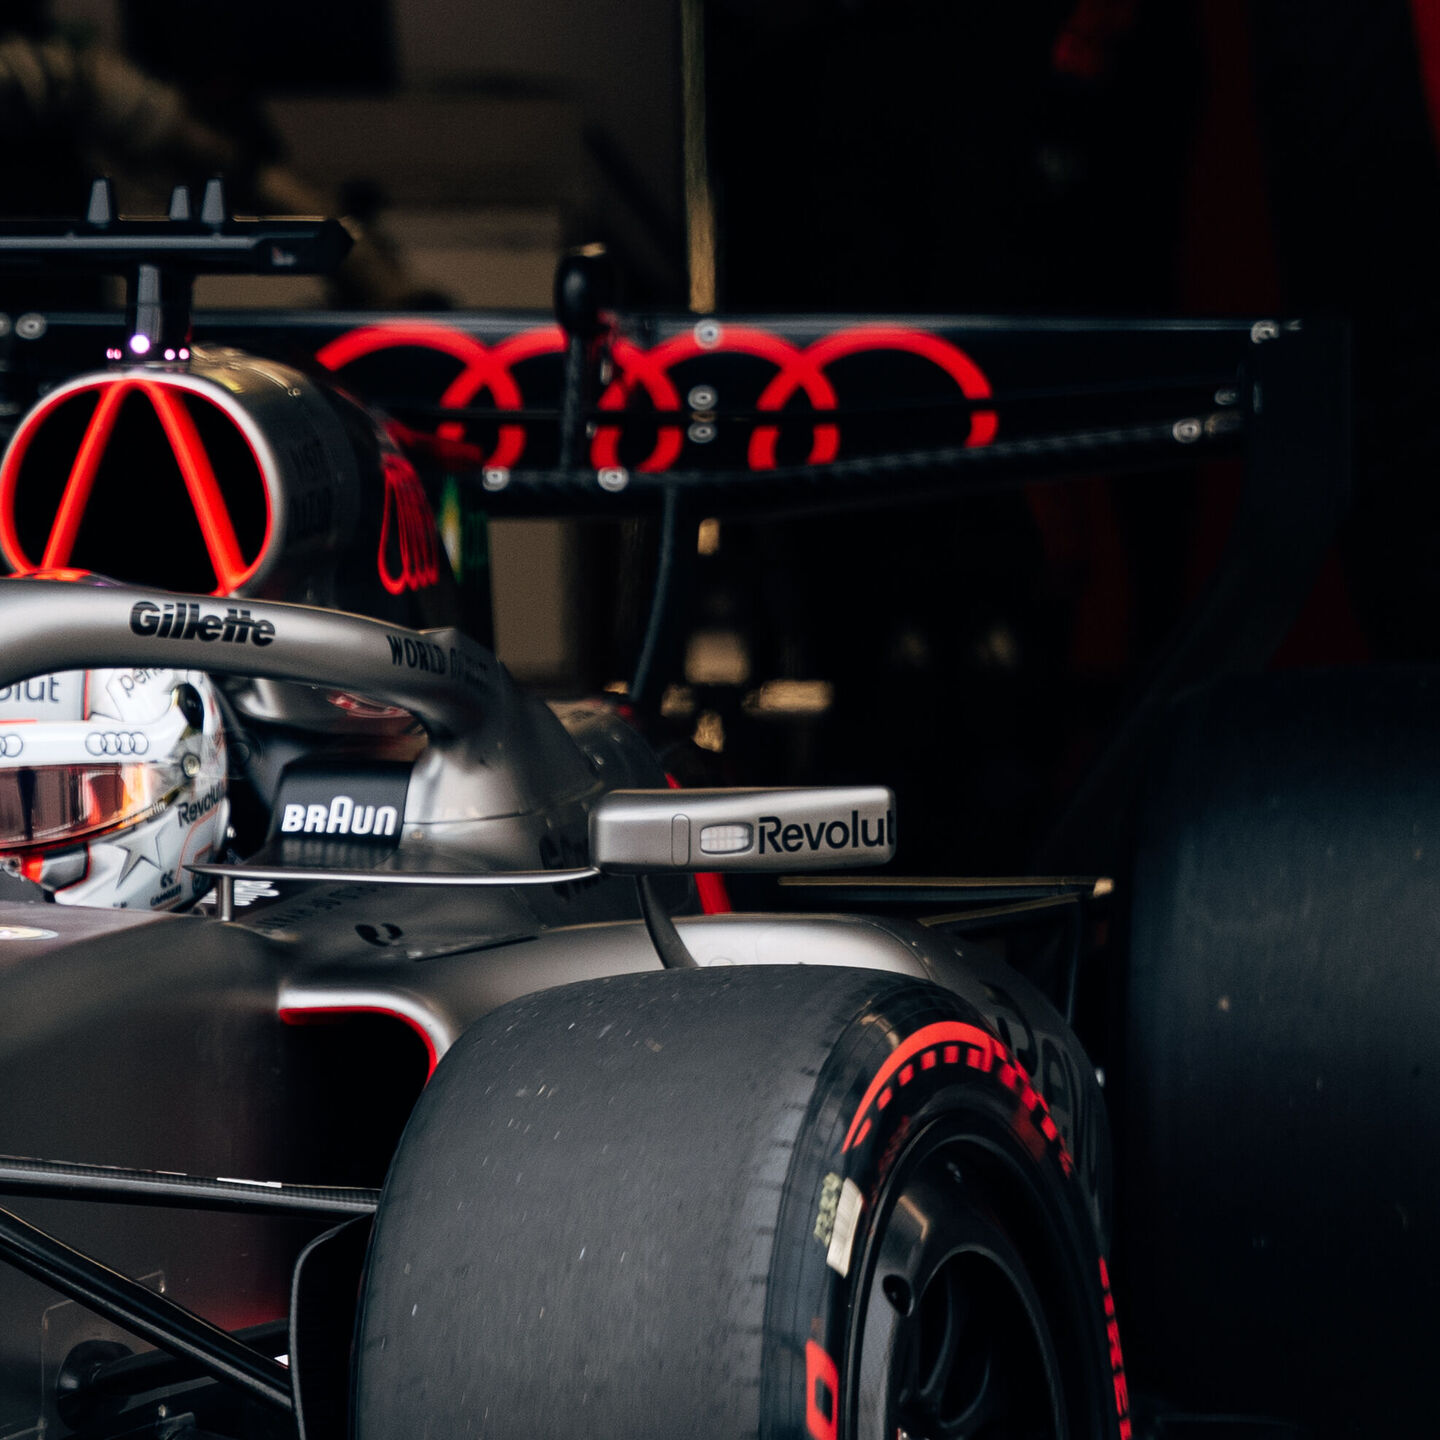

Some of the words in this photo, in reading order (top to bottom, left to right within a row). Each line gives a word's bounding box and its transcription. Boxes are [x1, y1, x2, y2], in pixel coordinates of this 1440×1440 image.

[129, 601, 276, 647] Gillette
[386, 634, 446, 675] WORLD
[281, 795, 398, 836] BRAUN
